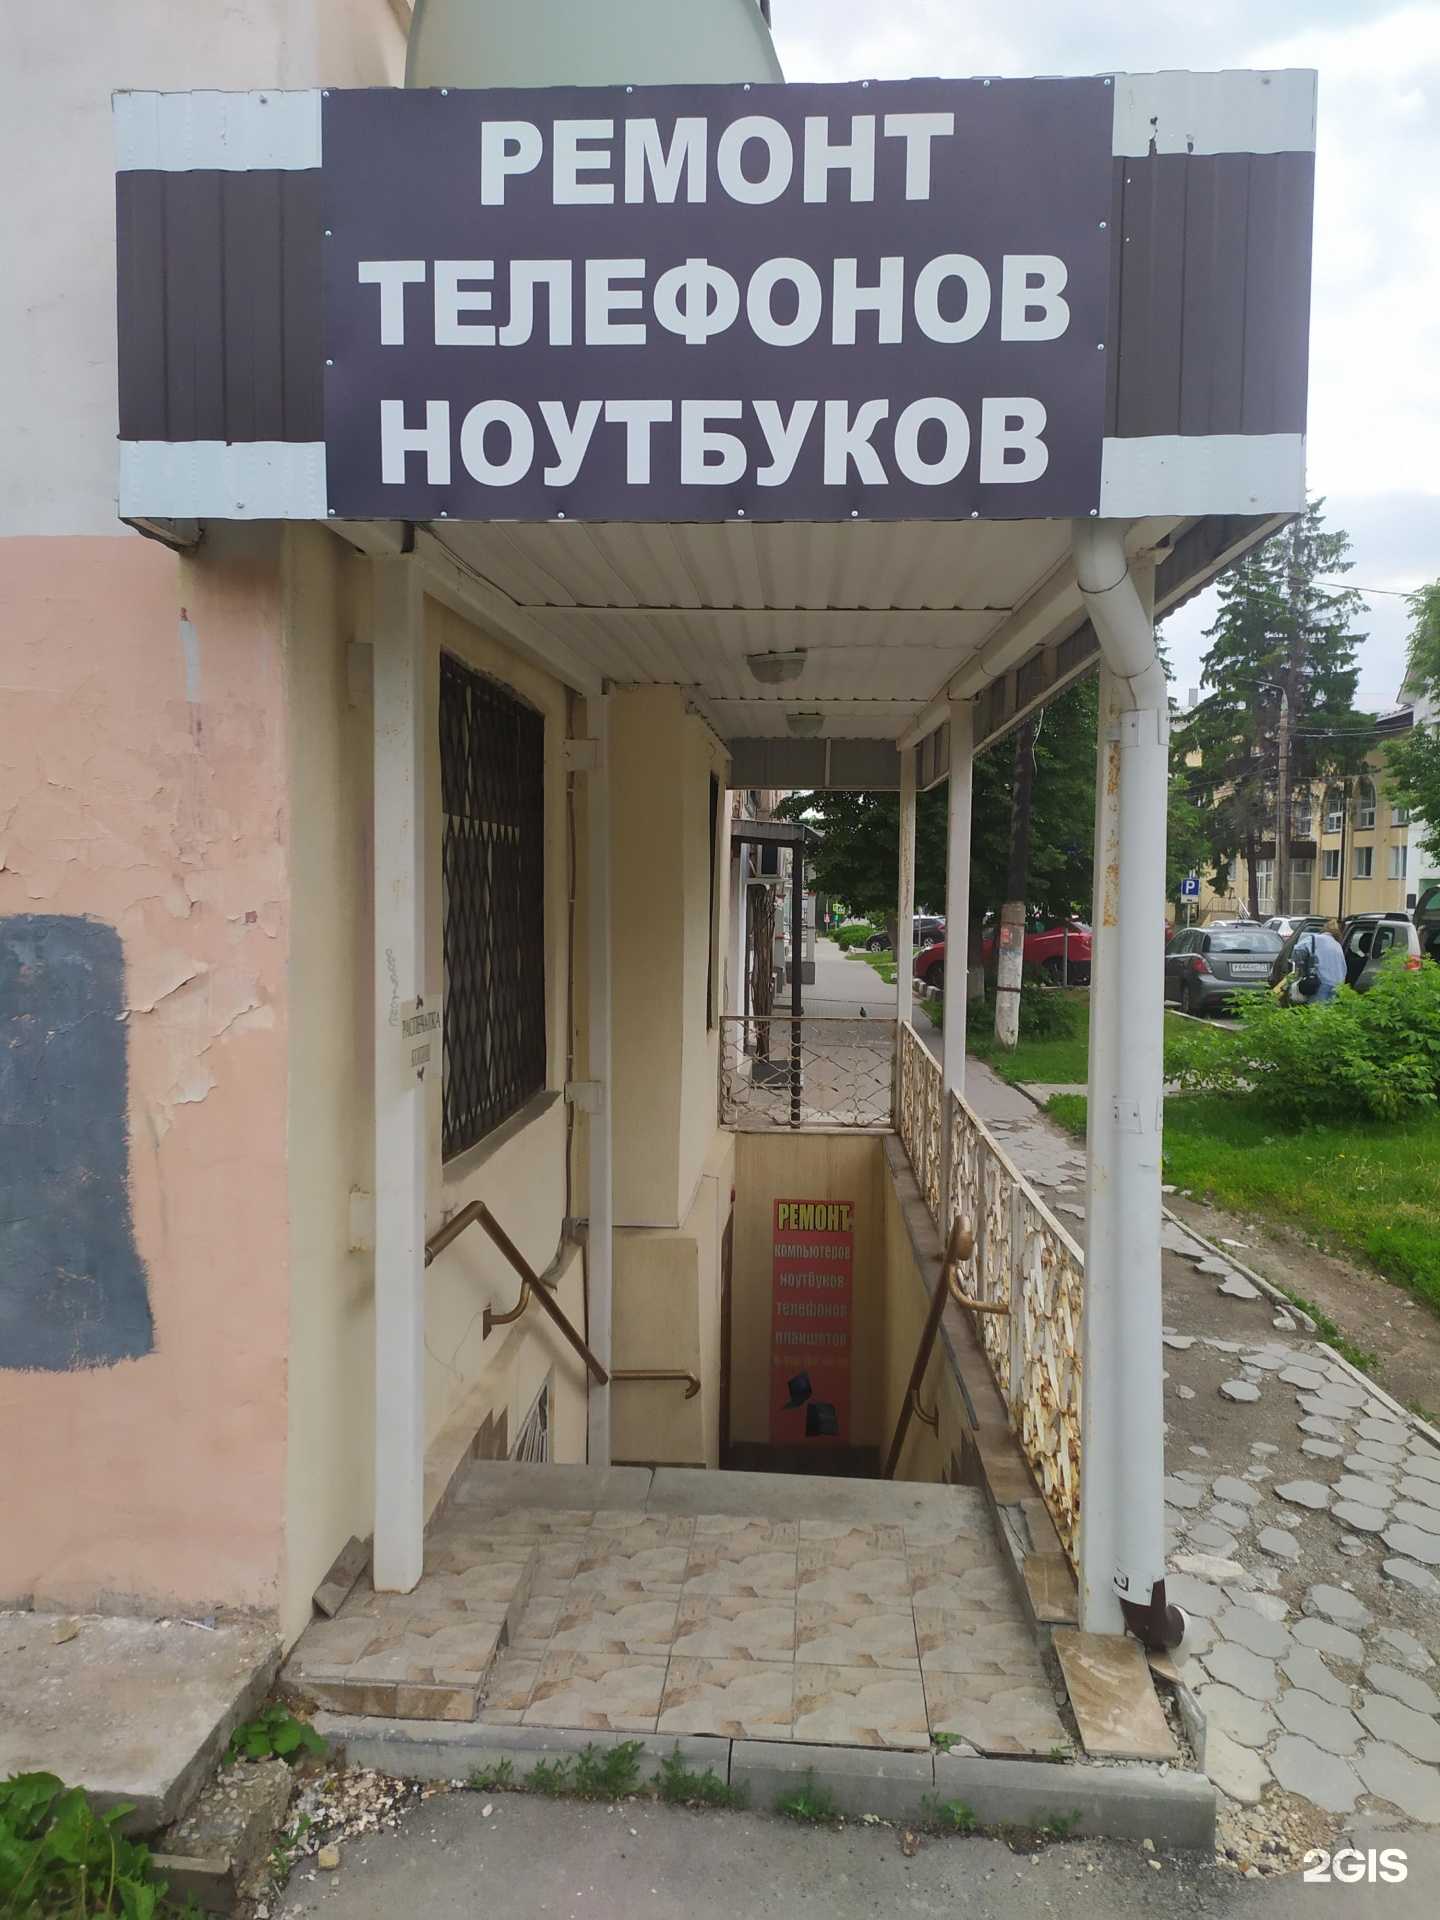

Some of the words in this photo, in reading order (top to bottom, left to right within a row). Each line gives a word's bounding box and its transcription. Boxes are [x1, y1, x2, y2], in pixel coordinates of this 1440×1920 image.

[480, 112, 955, 206] РЕМОНТ
[358, 253, 1071, 347] ТЕЛЕФОНОВ
[380, 396, 1050, 487] НОУТБУКОВ
[777, 1202, 850, 1232] РЕМОНТ
